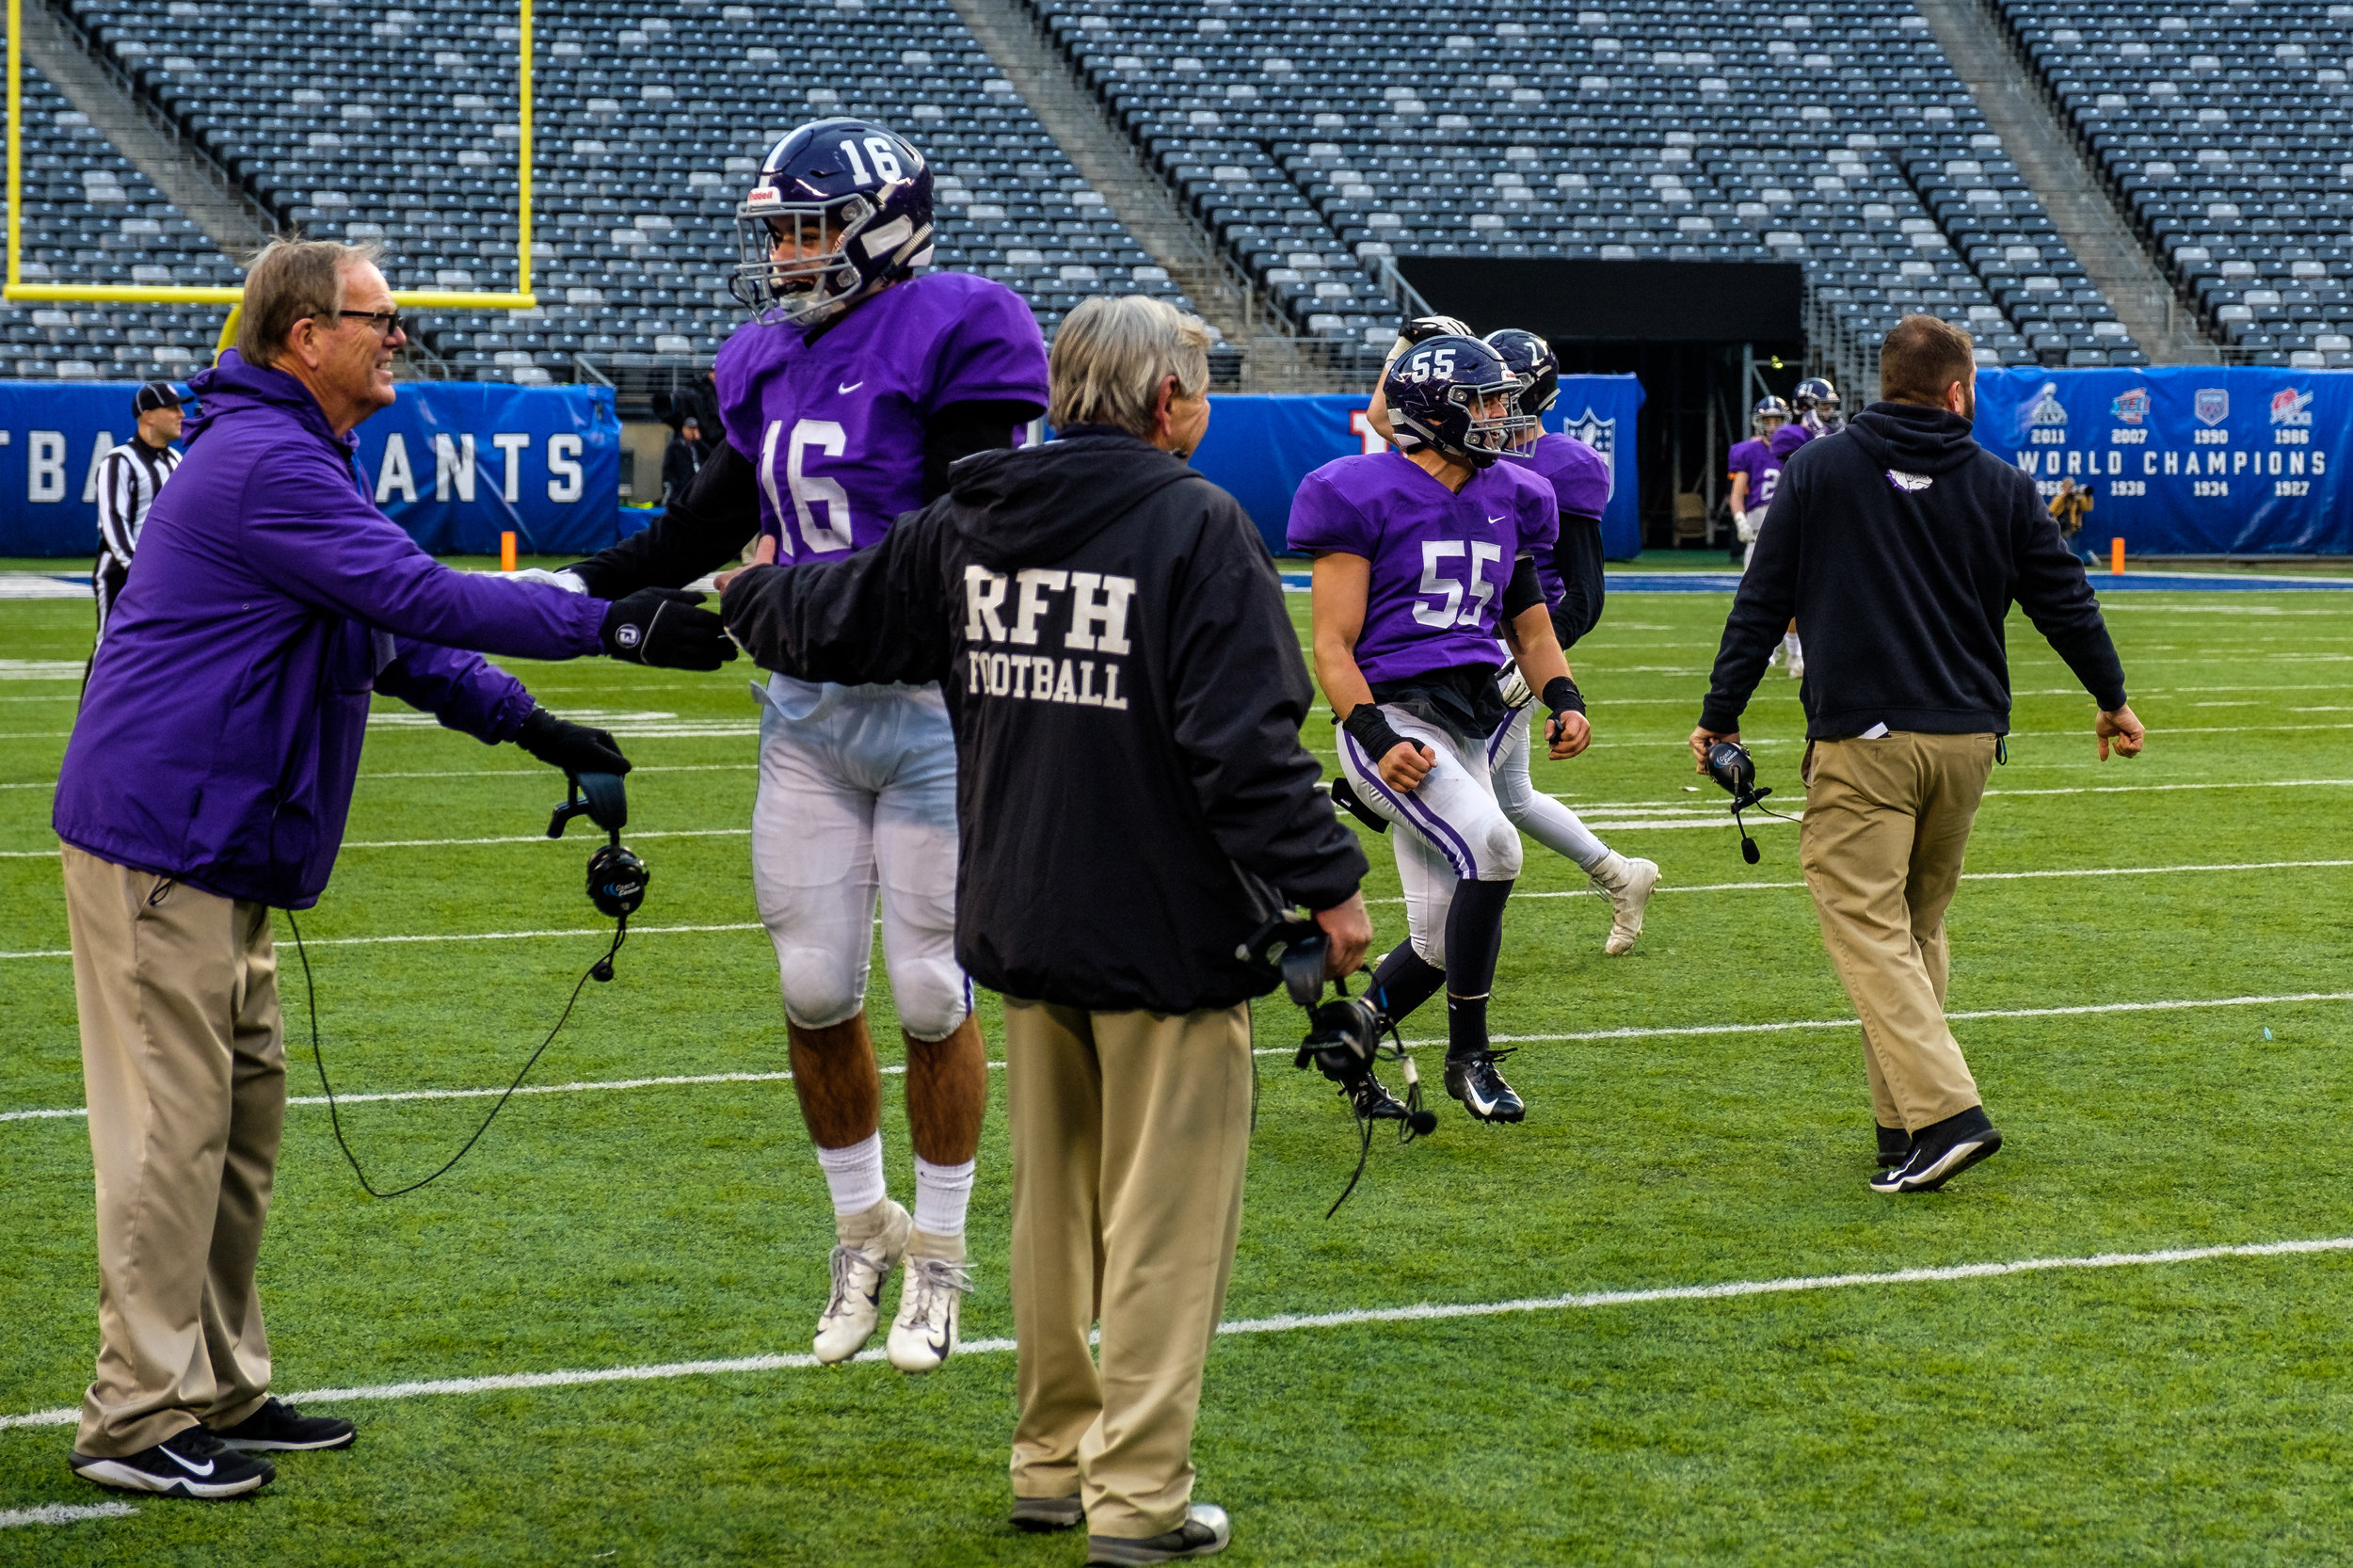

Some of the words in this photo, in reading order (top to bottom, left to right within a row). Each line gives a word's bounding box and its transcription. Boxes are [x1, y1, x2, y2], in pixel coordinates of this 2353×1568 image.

[839, 136, 902, 186] 16
[1411, 348, 1456, 384] 55
[2030, 427, 2066, 445] 2011
[2110, 427, 2148, 445] 2007
[2194, 427, 2230, 445] 1990
[2274, 427, 2311, 445] 1986
[2016, 450, 2122, 476] WORLD
[2143, 450, 2327, 476] CHAMPIONS
[760, 418, 853, 558] 16
[2110, 480, 2147, 497] 1938
[2194, 480, 2230, 497] 1934
[2274, 480, 2311, 497] 1927
[1412, 539, 1501, 630] 55
[963, 564, 1137, 656] RFH
